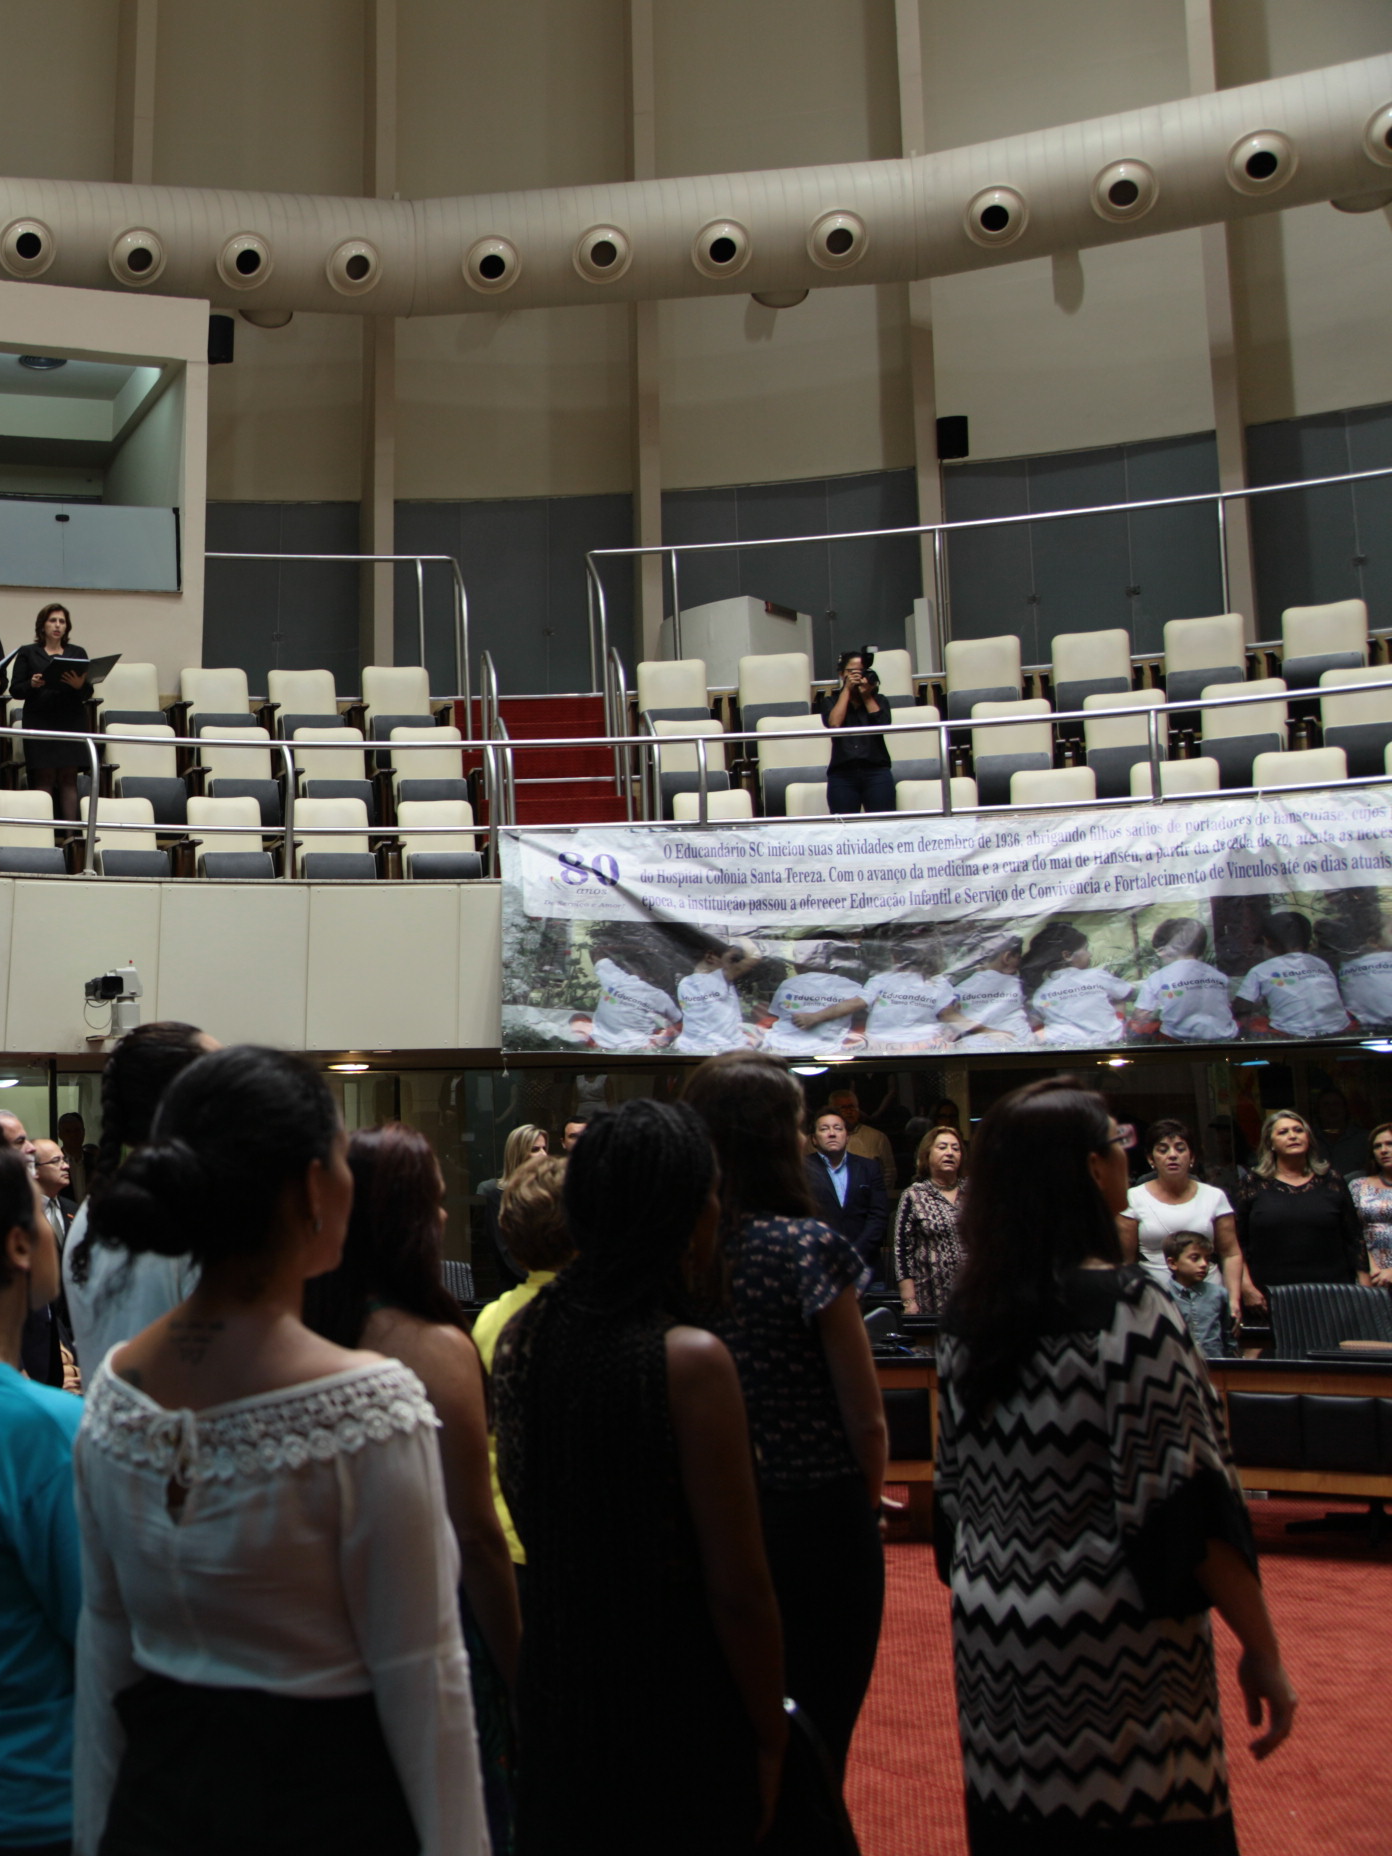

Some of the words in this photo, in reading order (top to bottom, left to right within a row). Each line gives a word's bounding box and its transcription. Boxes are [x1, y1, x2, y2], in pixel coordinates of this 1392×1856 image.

[664, 843, 672, 859] O
[675, 842, 746, 859] Educandário
[749, 841, 765, 857] SC
[768, 841, 805, 857] iniciou
[808, 843, 833, 856] suas
[836, 838, 894, 855] atividades
[897, 840, 914, 854] em
[917, 834, 975, 853] dezembro
[978, 834, 992, 849] de
[1026, 826, 1087, 848] abrigando
[1089, 825, 1122, 841] filhos
[1126, 821, 1163, 838] sadios
[1167, 819, 1181, 834] de
[1185, 814, 1252, 837] portadores
[1255, 812, 1270, 826] de
[1352, 803, 1387, 822] cujos
[558, 851, 620, 886] 80
[640, 869, 654, 883] do
[657, 869, 703, 888] Hospital
[750, 868, 782, 885] Santa
[785, 867, 826, 883] Tereza.
[829, 866, 854, 882] Com
[857, 869, 864, 881] o
[867, 867, 907, 884] avanço
[910, 863, 924, 879] da
[927, 860, 979, 878] medicina
[982, 863, 989, 875] e
[992, 862, 999, 873] a
[1002, 859, 1029, 873] cura
[1032, 854, 1047, 871] do
[1050, 852, 1072, 870] mal
[1075, 853, 1090, 868] de
[1194, 841, 1210, 855] da
[1257, 833, 1272, 848] de
[679, 899, 685, 909] a
[688, 895, 746, 914] instituição
[749, 898, 787, 915] passou
[790, 898, 797, 910] a
[799, 894, 847, 910] oferecer
[850, 892, 905, 911] Educação
[909, 888, 951, 905] Infantil
[955, 891, 961, 903] e
[964, 885, 1008, 906] Serviço
[1011, 884, 1025, 901] de
[1104, 880, 1111, 892] e
[1114, 868, 1206, 892] Fortalecimento
[1209, 864, 1224, 880] de
[1280, 858, 1300, 875] até
[1303, 860, 1318, 874] os
[1321, 854, 1348, 873] dias
